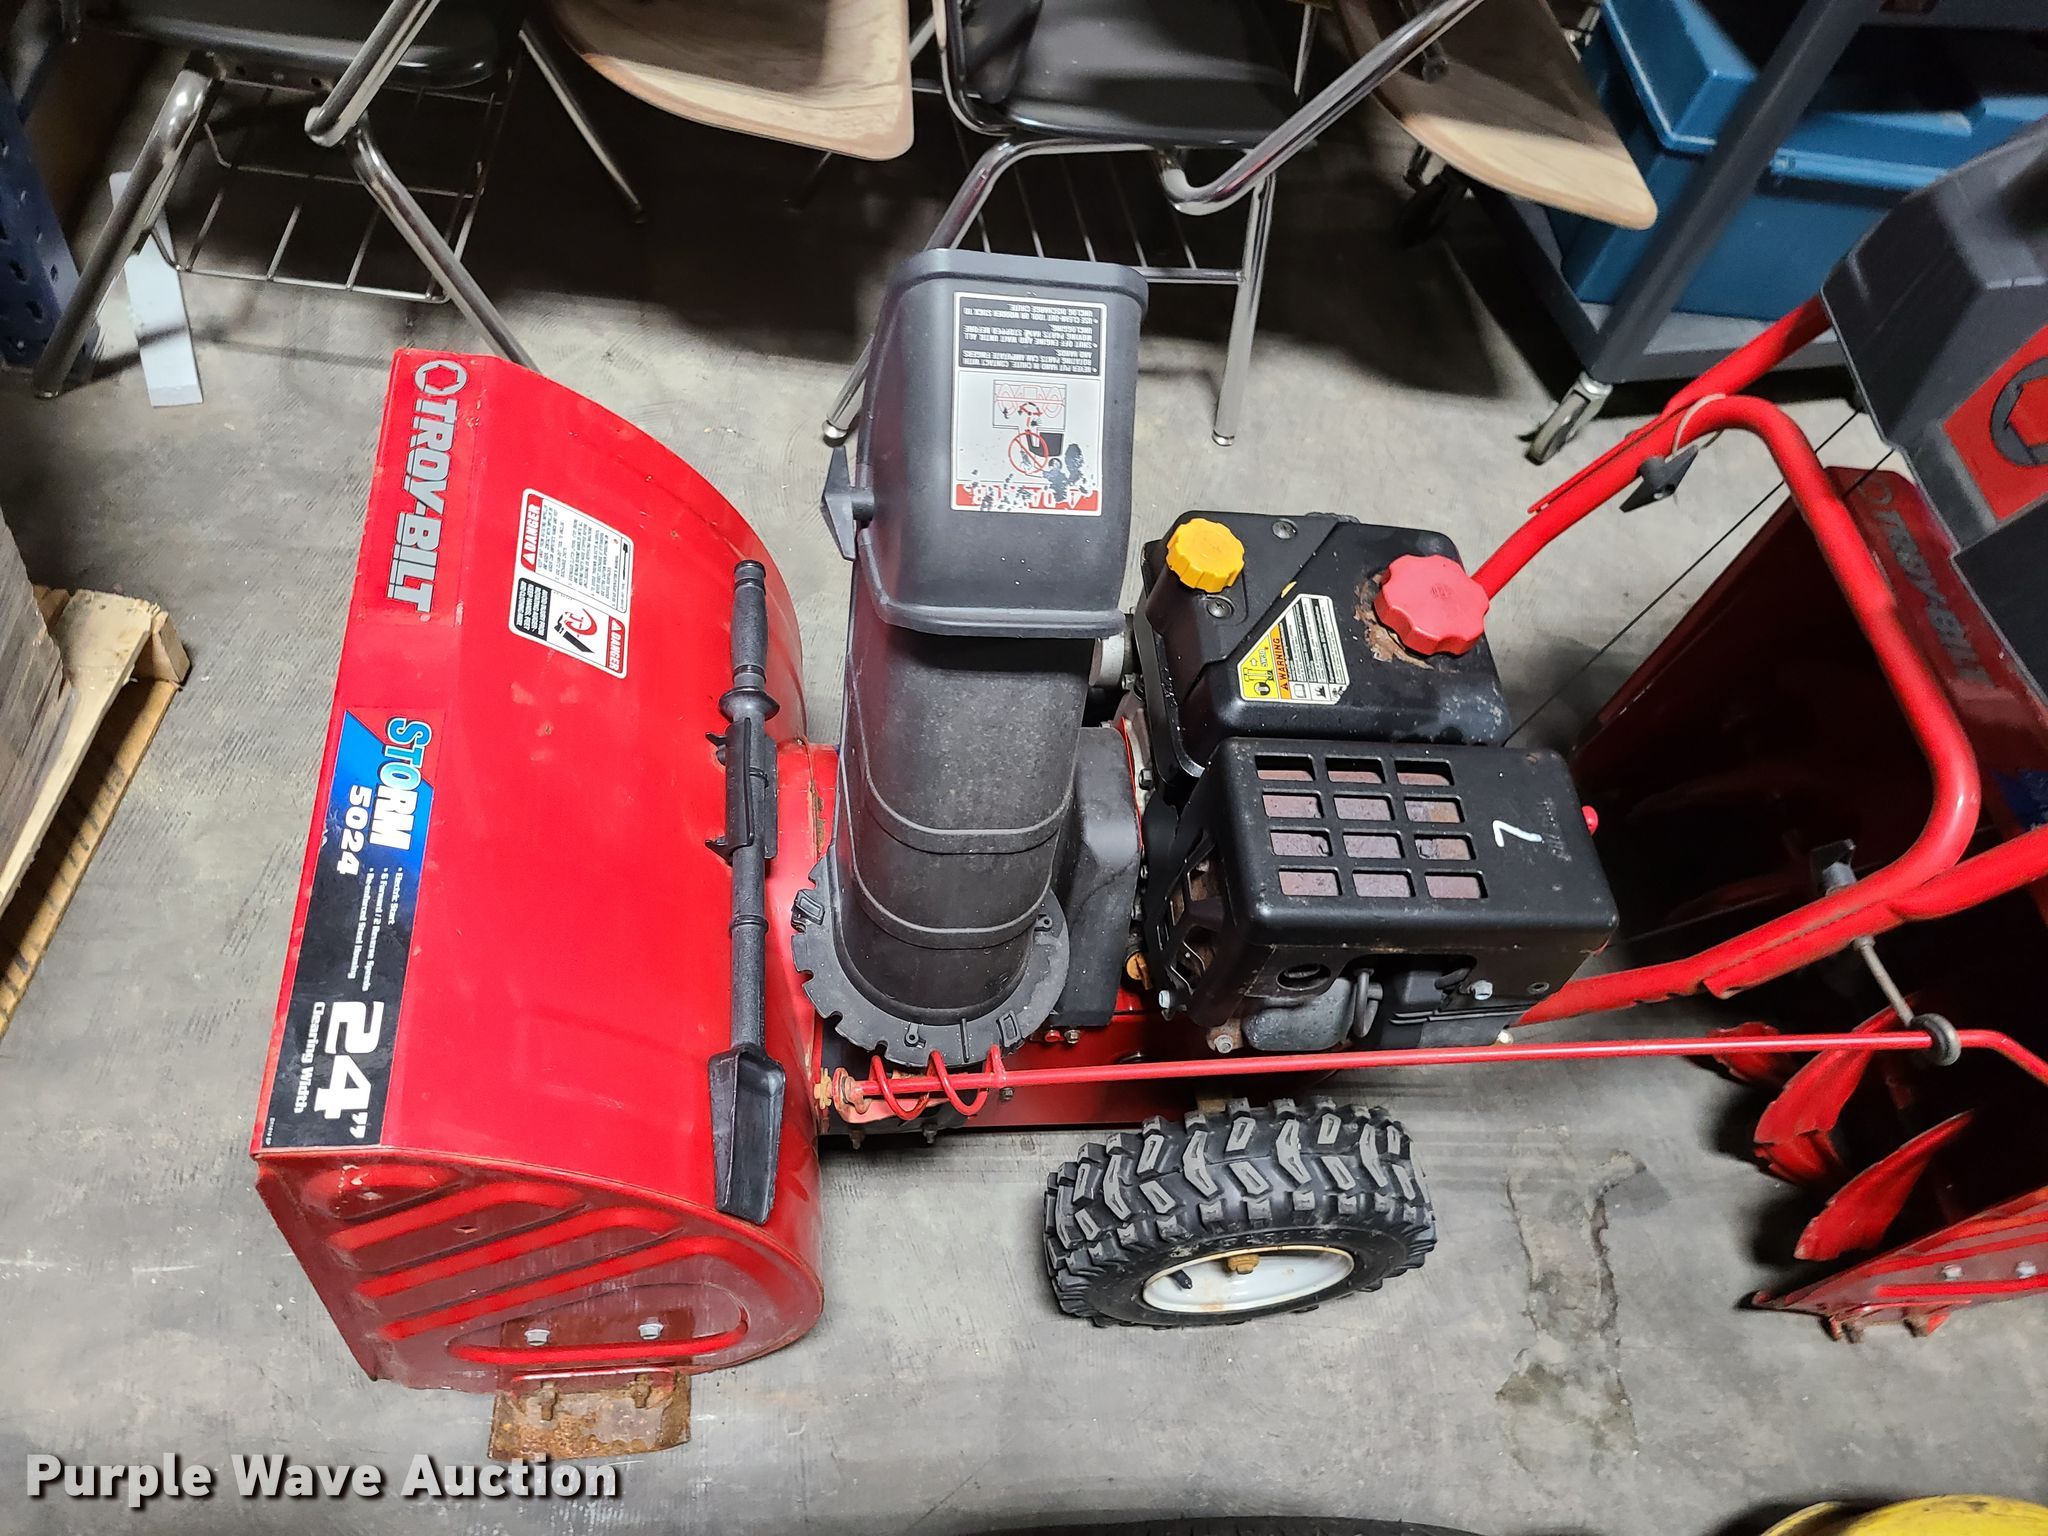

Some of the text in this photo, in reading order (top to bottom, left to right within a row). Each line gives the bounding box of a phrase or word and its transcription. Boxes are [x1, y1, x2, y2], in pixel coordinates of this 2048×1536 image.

[1040, 355, 1060, 364] PARTS
[387, 397, 460, 614] TROY-BILT
[524, 503, 540, 552] DANGER
[609, 631, 622, 670] DANGER
[1273, 638, 1287, 680] WARNING
[368, 717, 433, 851] STORM
[336, 784, 373, 876] 5024
[374, 880, 388, 913] Forward
[387, 872, 403, 925] Electric Start
[347, 873, 375, 979] Re-enforced Steel Housing
[368, 926, 380, 959] Reverse
[362, 960, 375, 992] Speeds
[292, 1001, 326, 1114] Clearing Width
